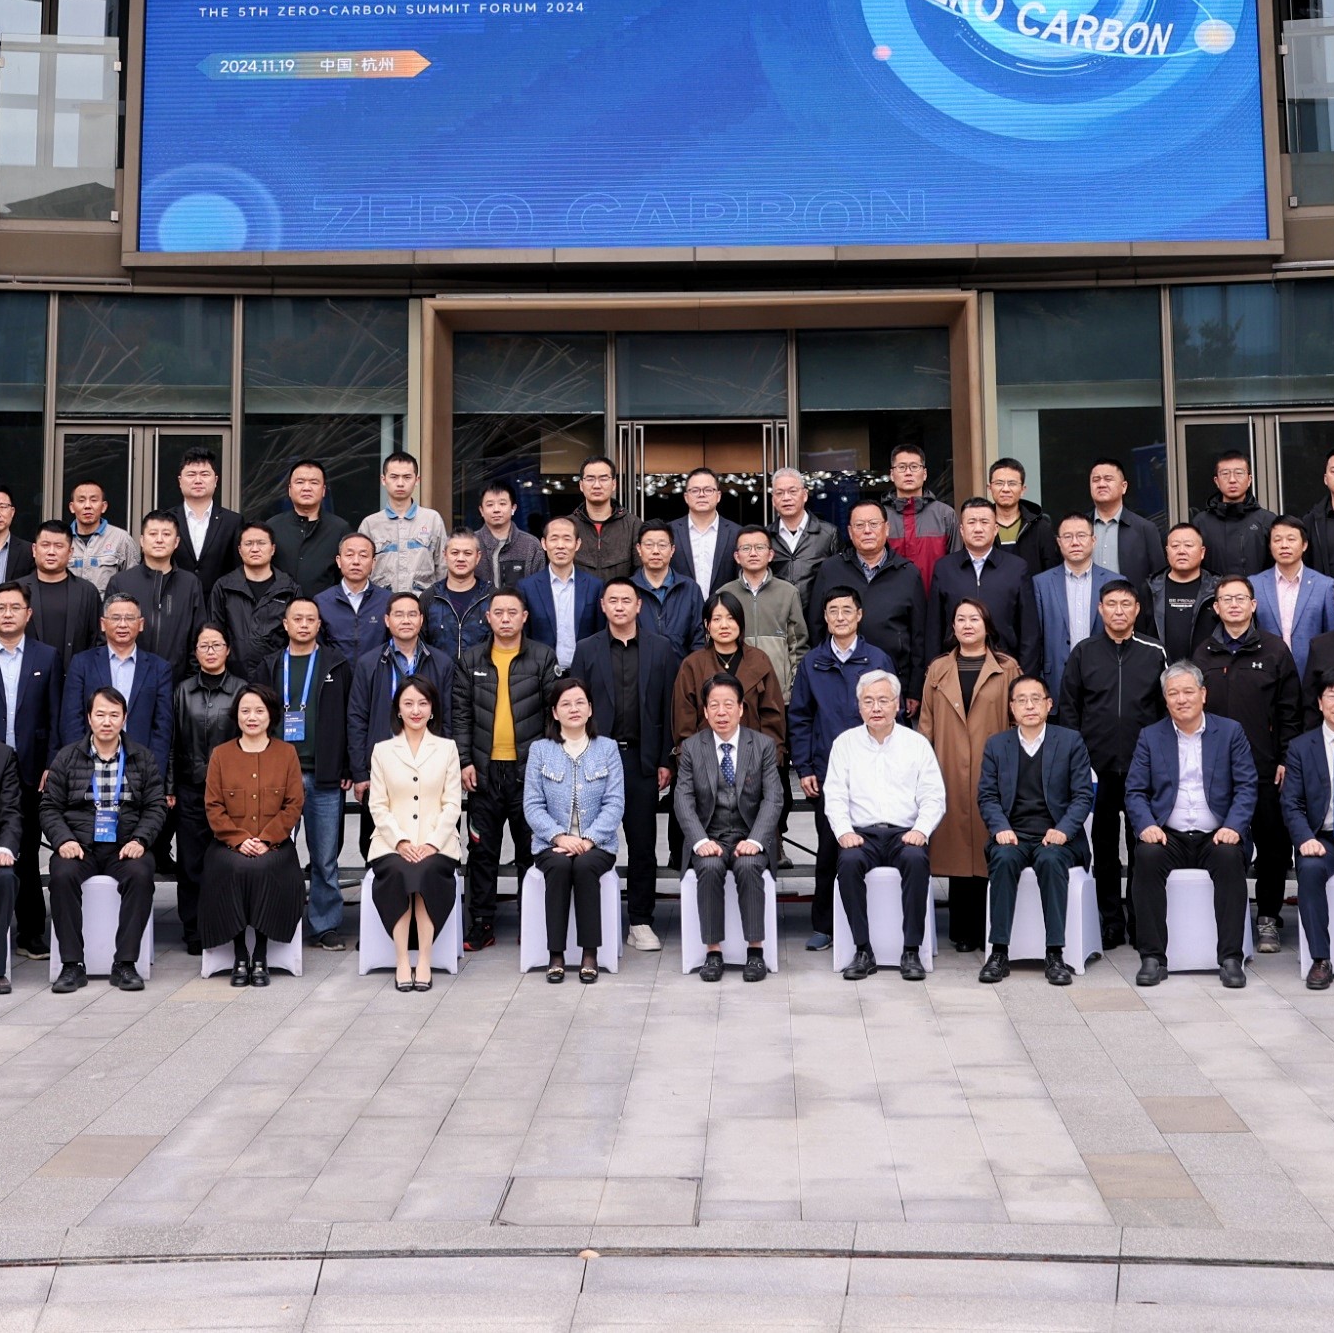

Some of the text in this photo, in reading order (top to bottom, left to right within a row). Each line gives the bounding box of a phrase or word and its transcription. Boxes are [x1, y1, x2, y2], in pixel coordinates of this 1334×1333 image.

[199, 2, 585, 17] THE 5TH ZERO-CARBON SUMMIT FORUM 2024
[1016, 1, 1174, 56] CARBON
[220, 57, 395, 73] 2024.11.19 中国·杭州
